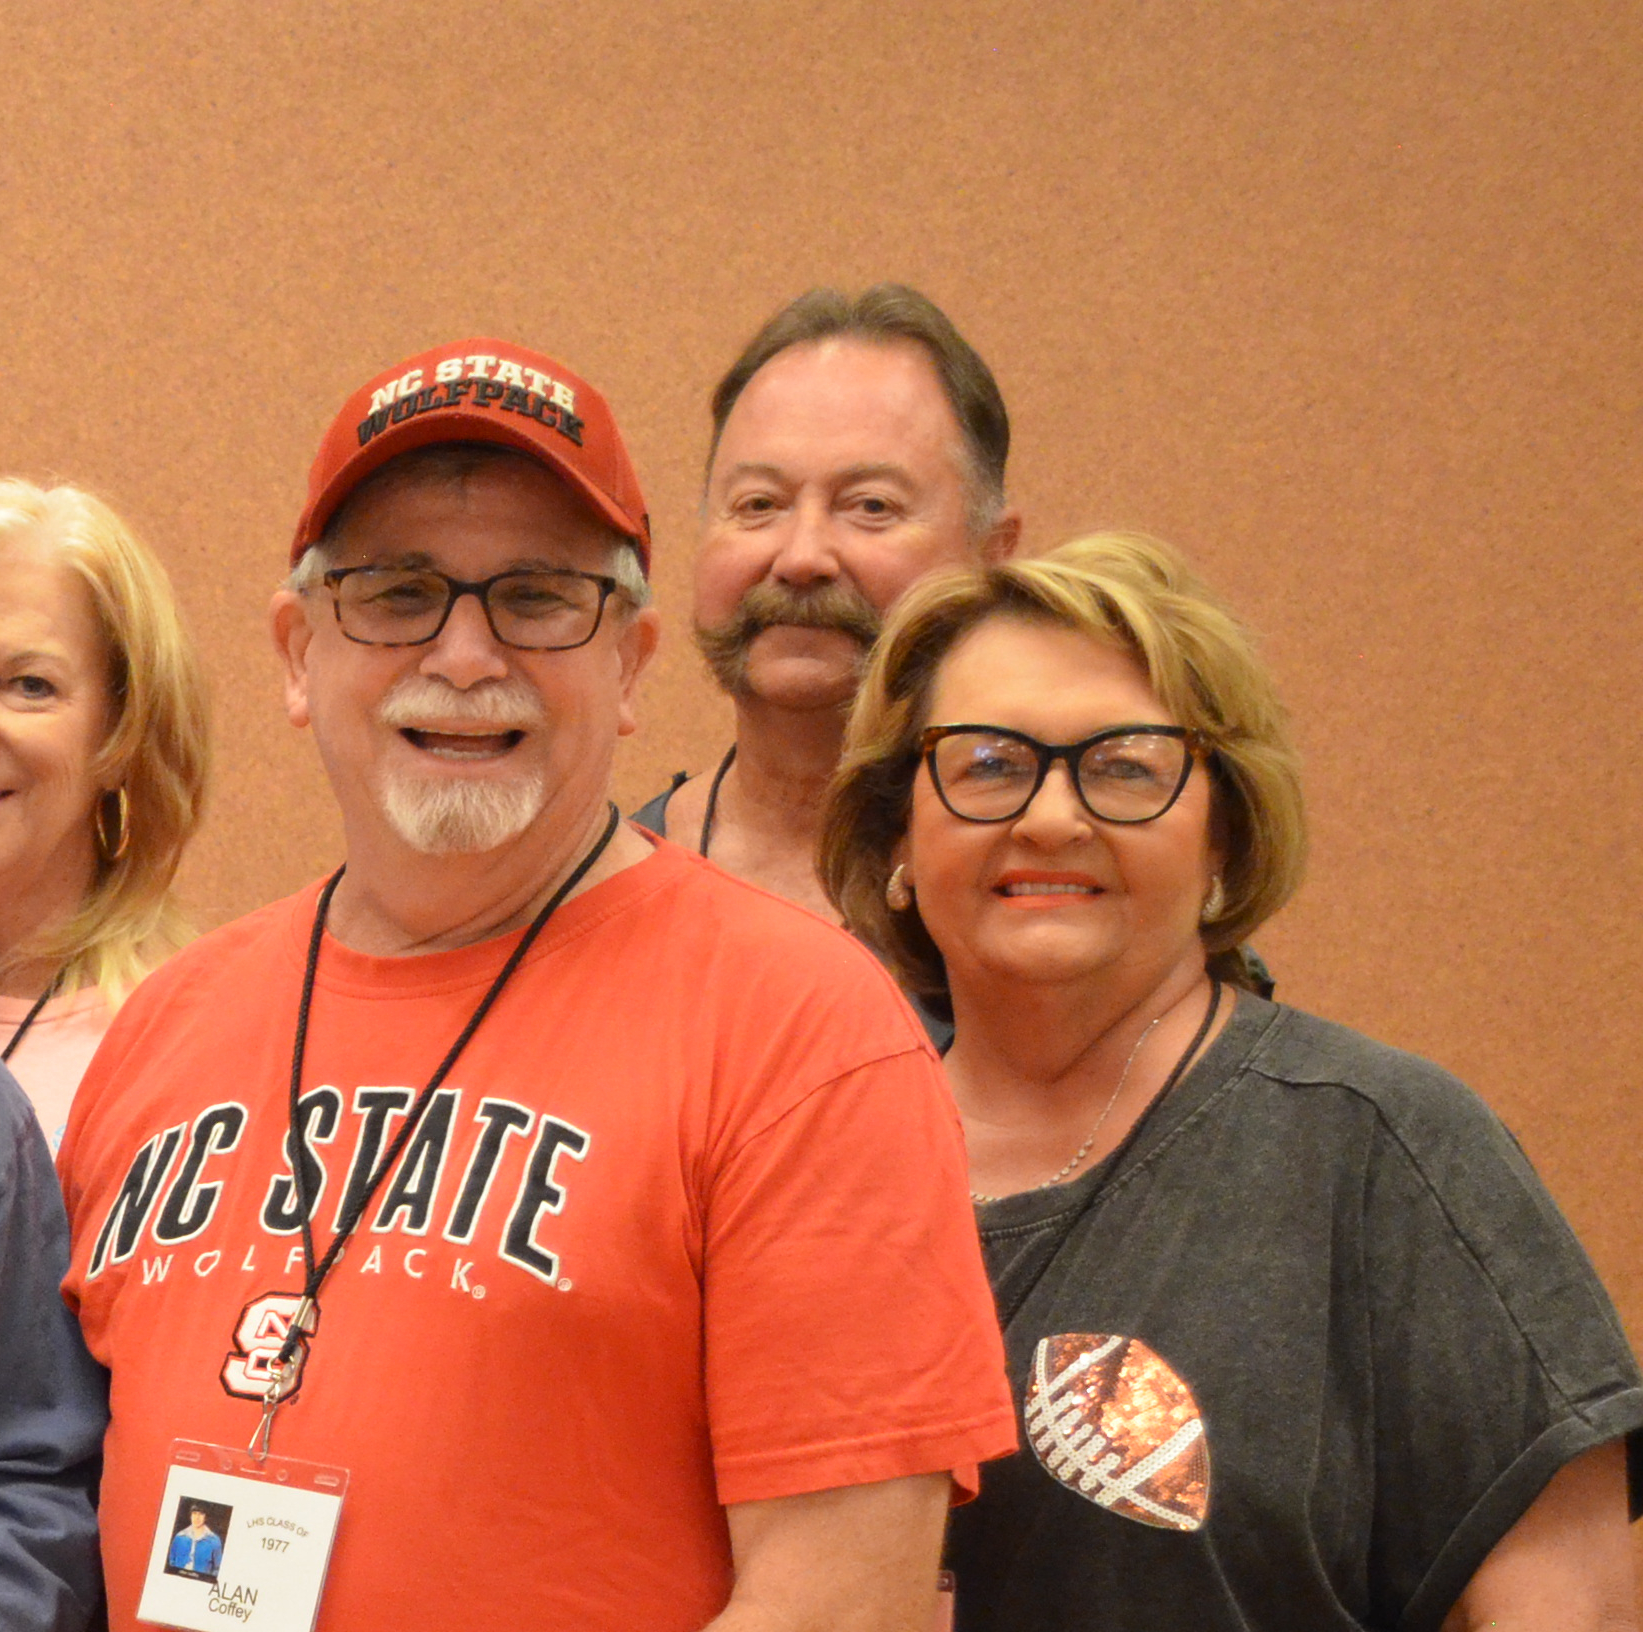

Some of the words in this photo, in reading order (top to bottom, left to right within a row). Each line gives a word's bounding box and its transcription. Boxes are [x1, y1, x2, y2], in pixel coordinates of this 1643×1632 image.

[367, 368, 424, 417] NC
[434, 354, 576, 416] STATE
[356, 376, 586, 448] WOLFPACK
[86, 1100, 249, 1283] NC
[258, 1083, 592, 1288] STATE
[266, 1516, 296, 1533] CLASS
[261, 1537, 291, 1554] 1977
[208, 1581, 259, 1606] ALAN
[207, 1598, 253, 1623] Coffey
